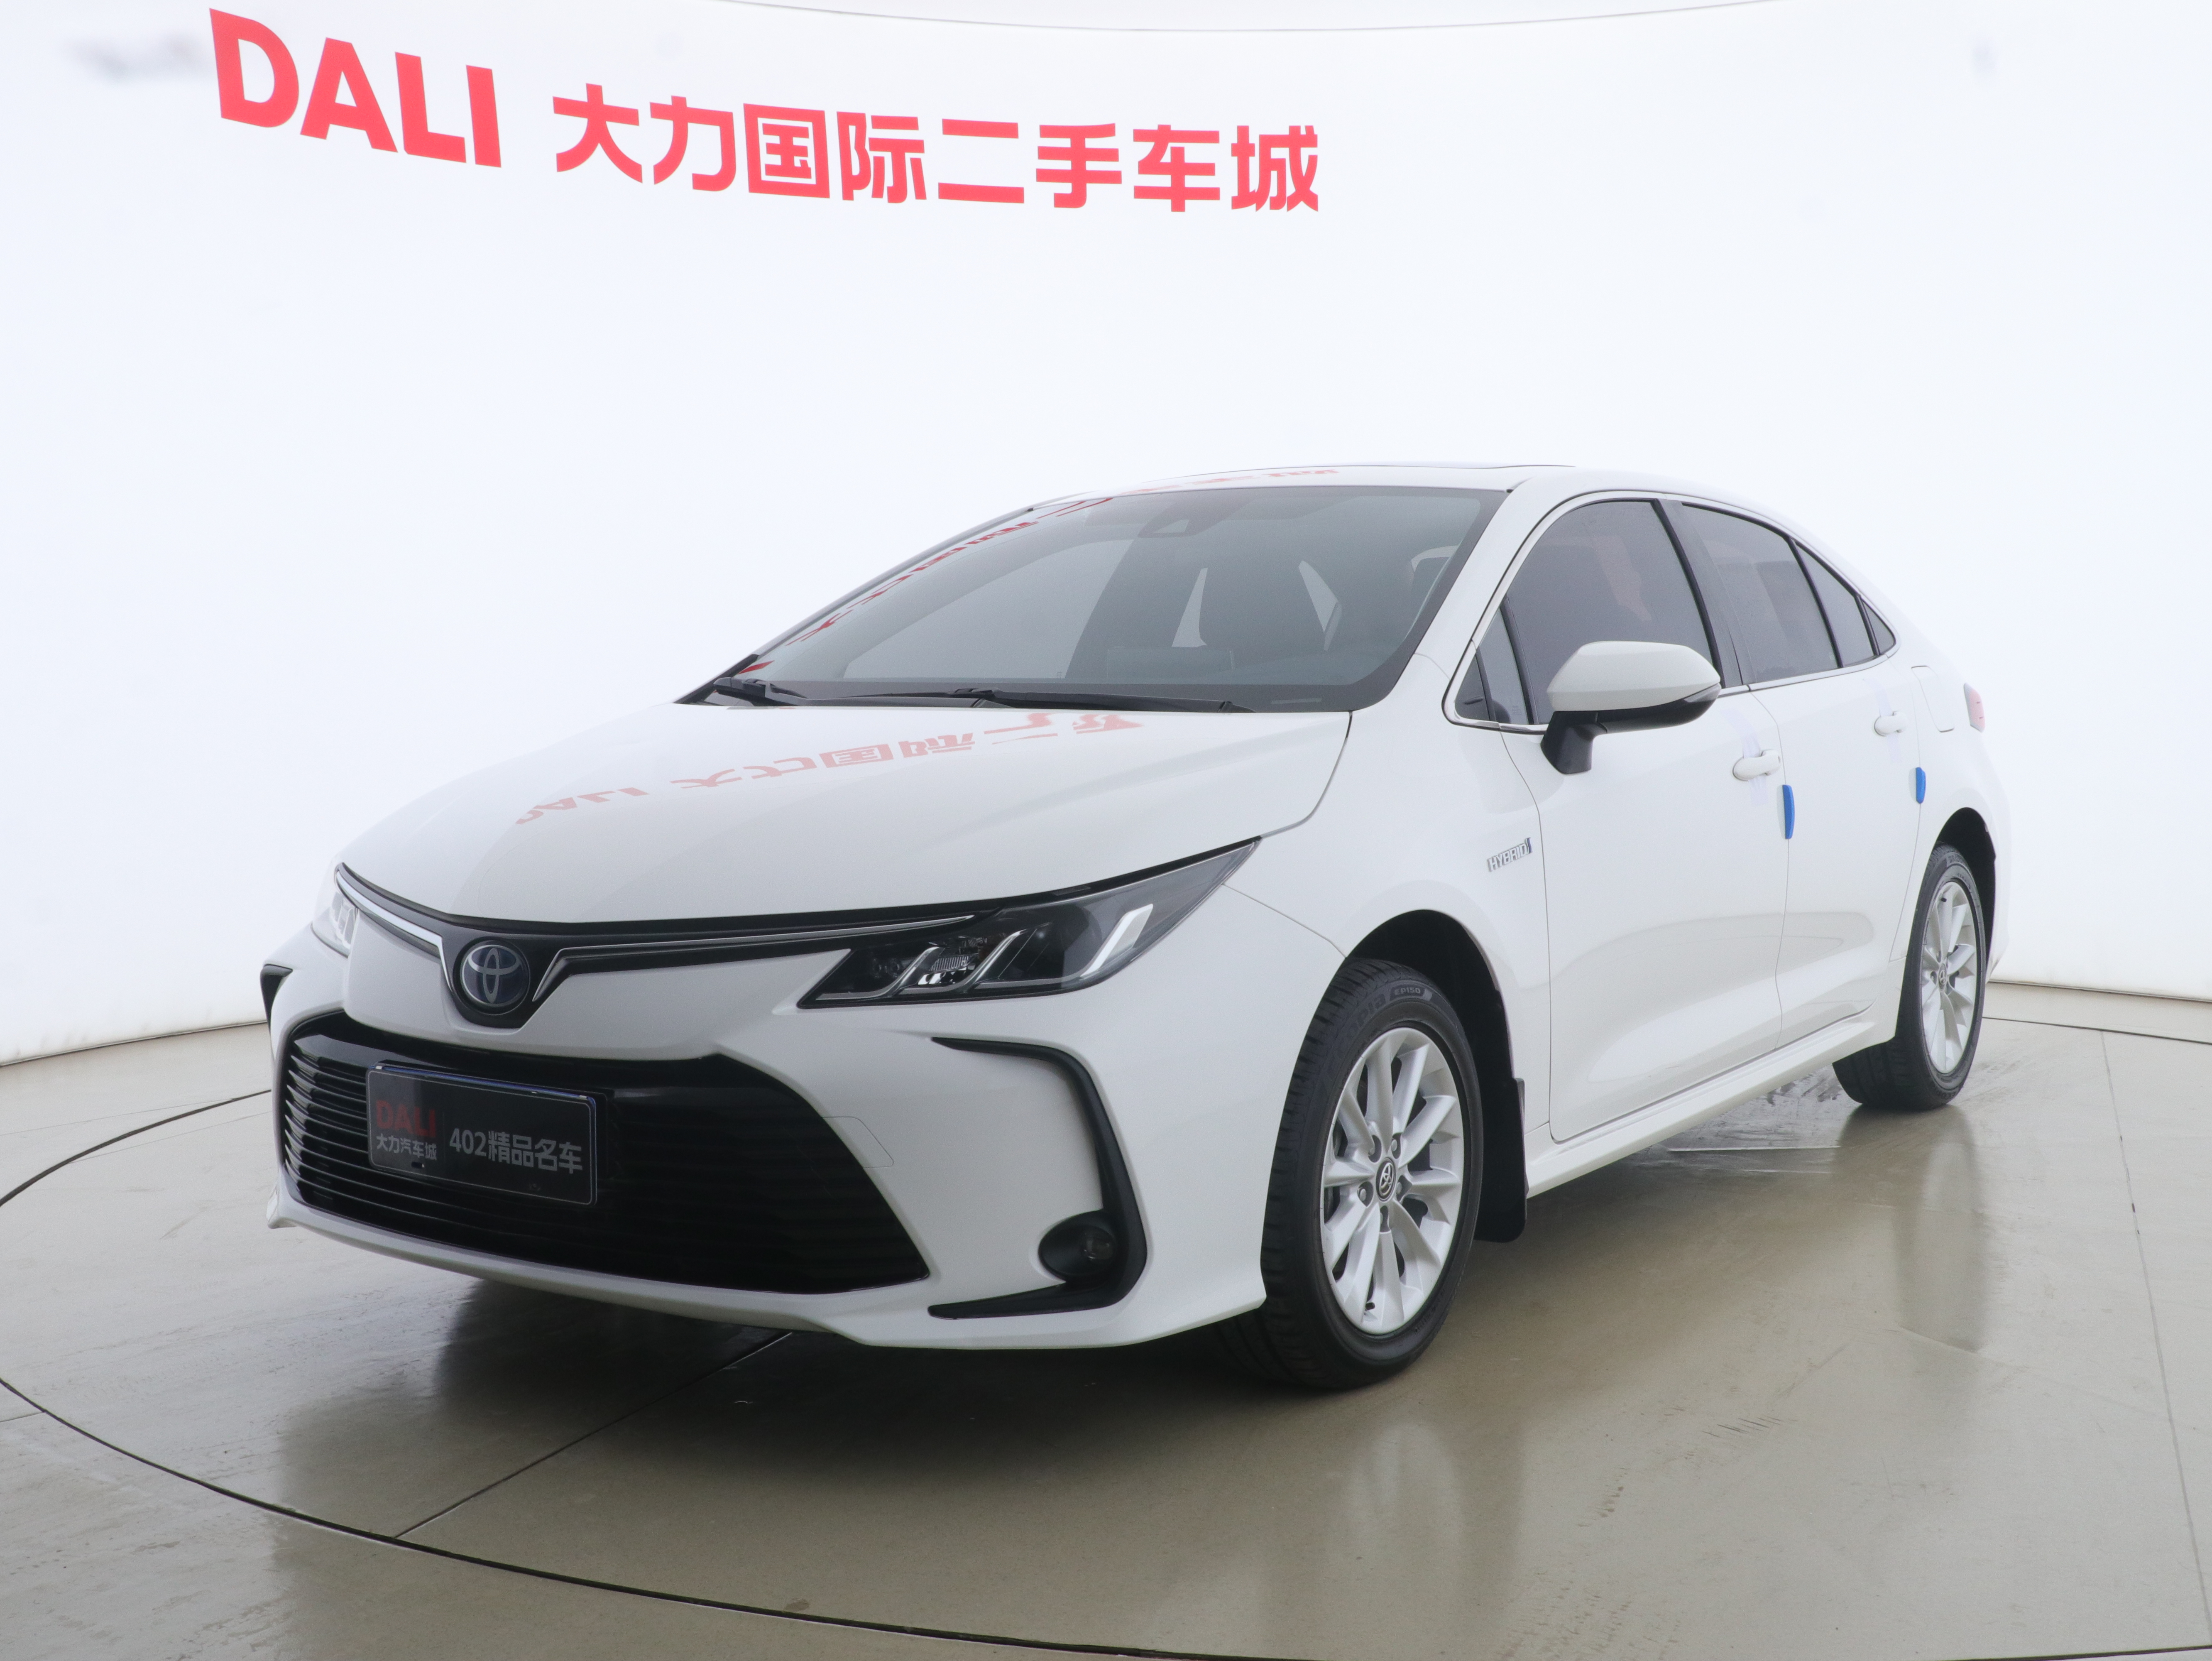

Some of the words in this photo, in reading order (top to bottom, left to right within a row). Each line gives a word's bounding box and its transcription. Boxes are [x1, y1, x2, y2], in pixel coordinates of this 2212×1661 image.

[210, 8, 501, 167] DALI
[553, 83, 1318, 212] 大力国际二手车城
[1487, 840, 1529, 872] HYBRID
[1395, 987, 1420, 995] EP150
[376, 1100, 436, 1138] DALI
[376, 1133, 437, 1161] 大力汽车城
[450, 1128, 582, 1174] 402精品名车
